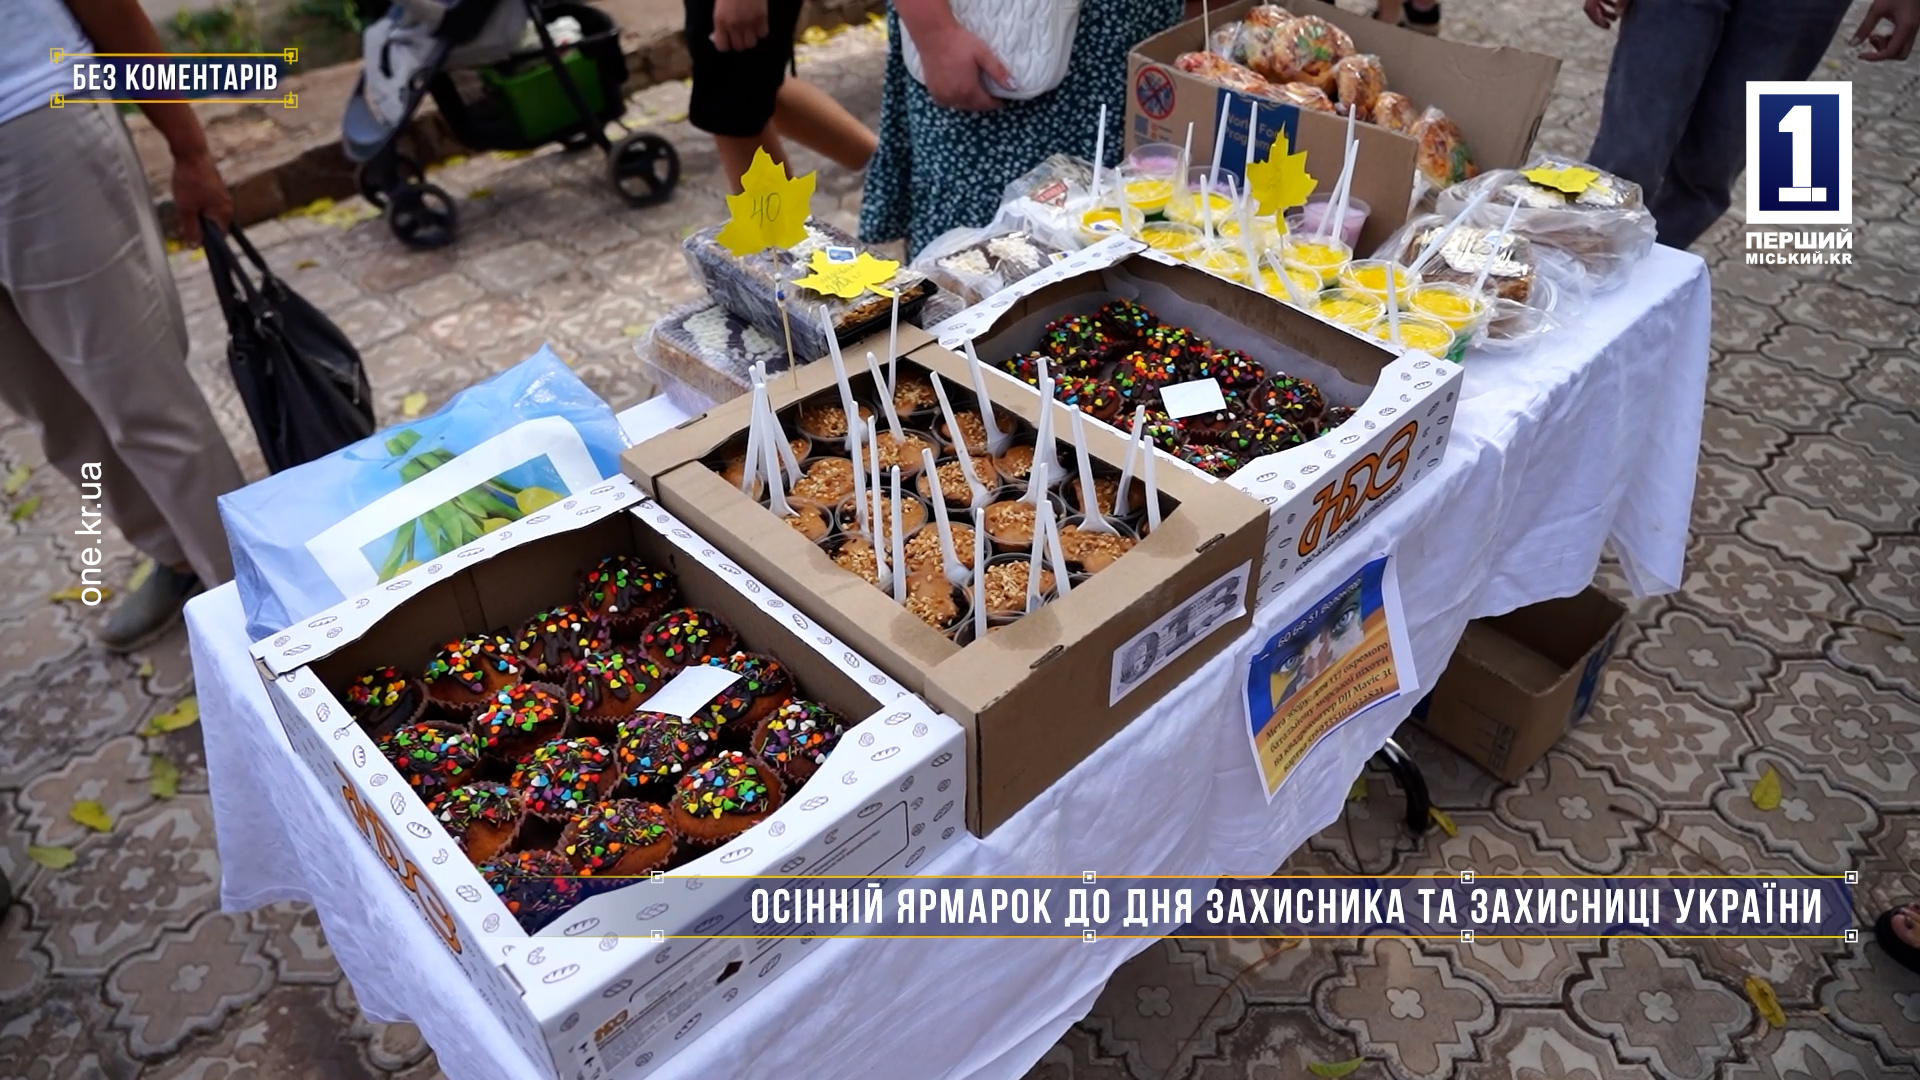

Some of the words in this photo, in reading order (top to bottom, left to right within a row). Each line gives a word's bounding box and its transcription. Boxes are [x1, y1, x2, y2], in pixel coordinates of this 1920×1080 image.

[751, 192, 781, 229] 40
[1343, 642, 1388, 674] окремого
[1355, 656, 1389, 680] піхоти
[1338, 690, 1352, 704] DJI
[1352, 674, 1380, 695] Mavic
